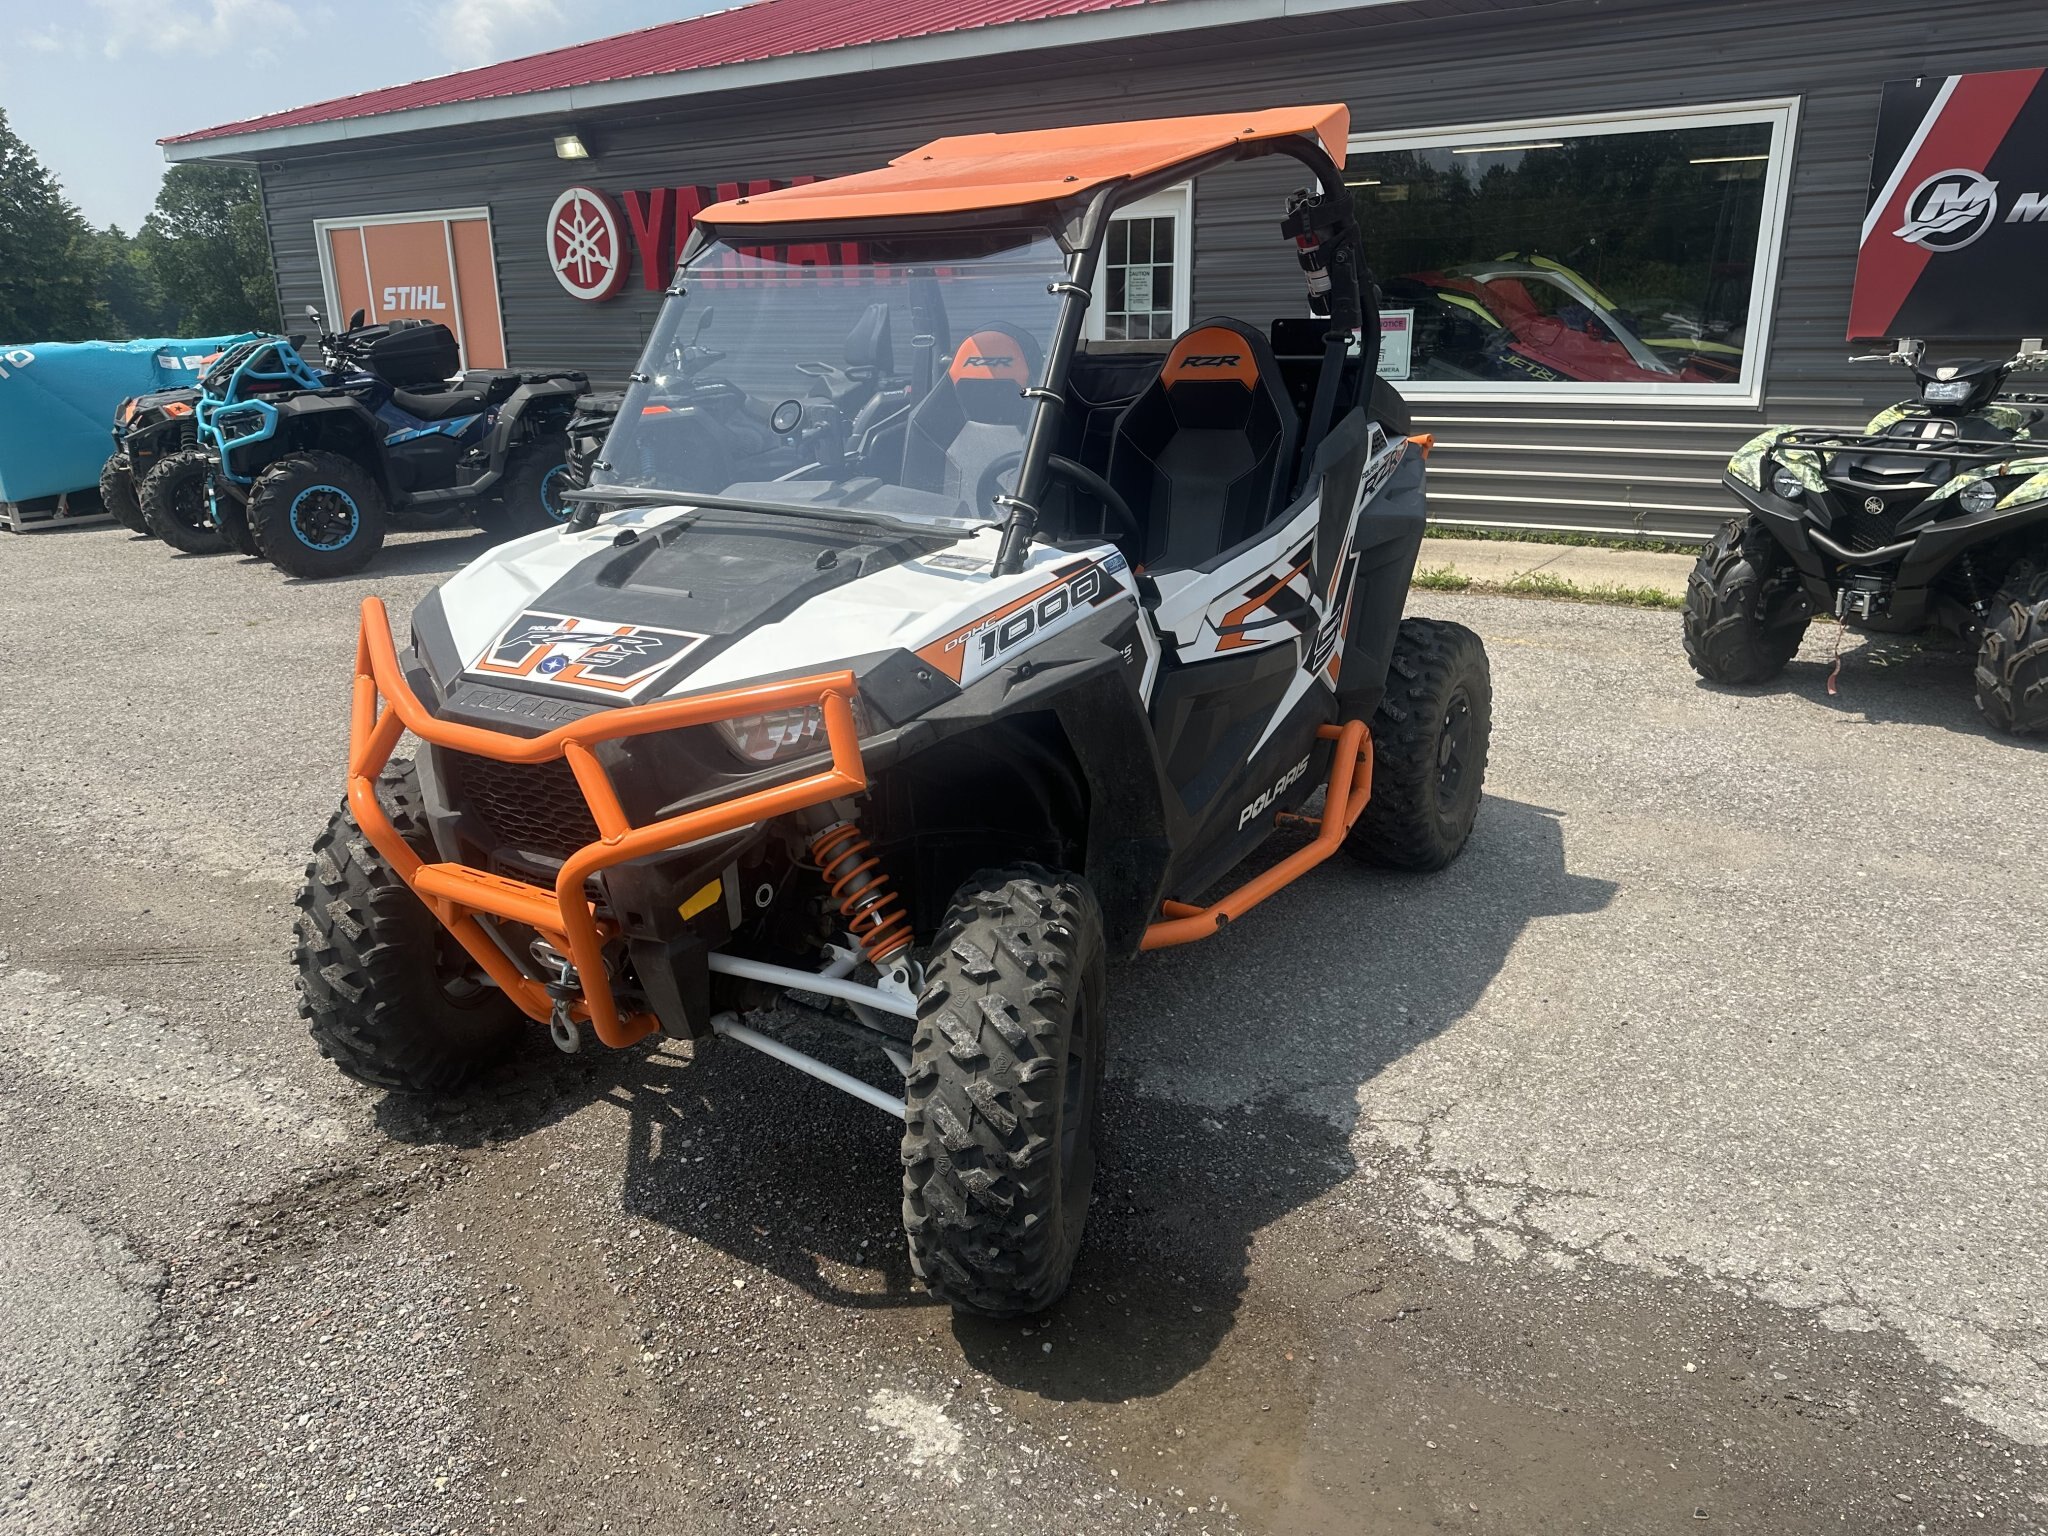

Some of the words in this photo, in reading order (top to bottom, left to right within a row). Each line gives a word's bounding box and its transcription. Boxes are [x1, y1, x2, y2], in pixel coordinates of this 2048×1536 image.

[383, 285, 446, 311] STIHL
[1381, 320, 1403, 328] OTICE
[962, 356, 1014, 368] RZR
[1179, 355, 1241, 369] RZR
[979, 568, 1100, 666] 1000
[498, 631, 663, 655] RZR
[944, 615, 997, 653] DOHC
[459, 690, 592, 722] POLARIS
[1238, 752, 1311, 832] POLARIS
